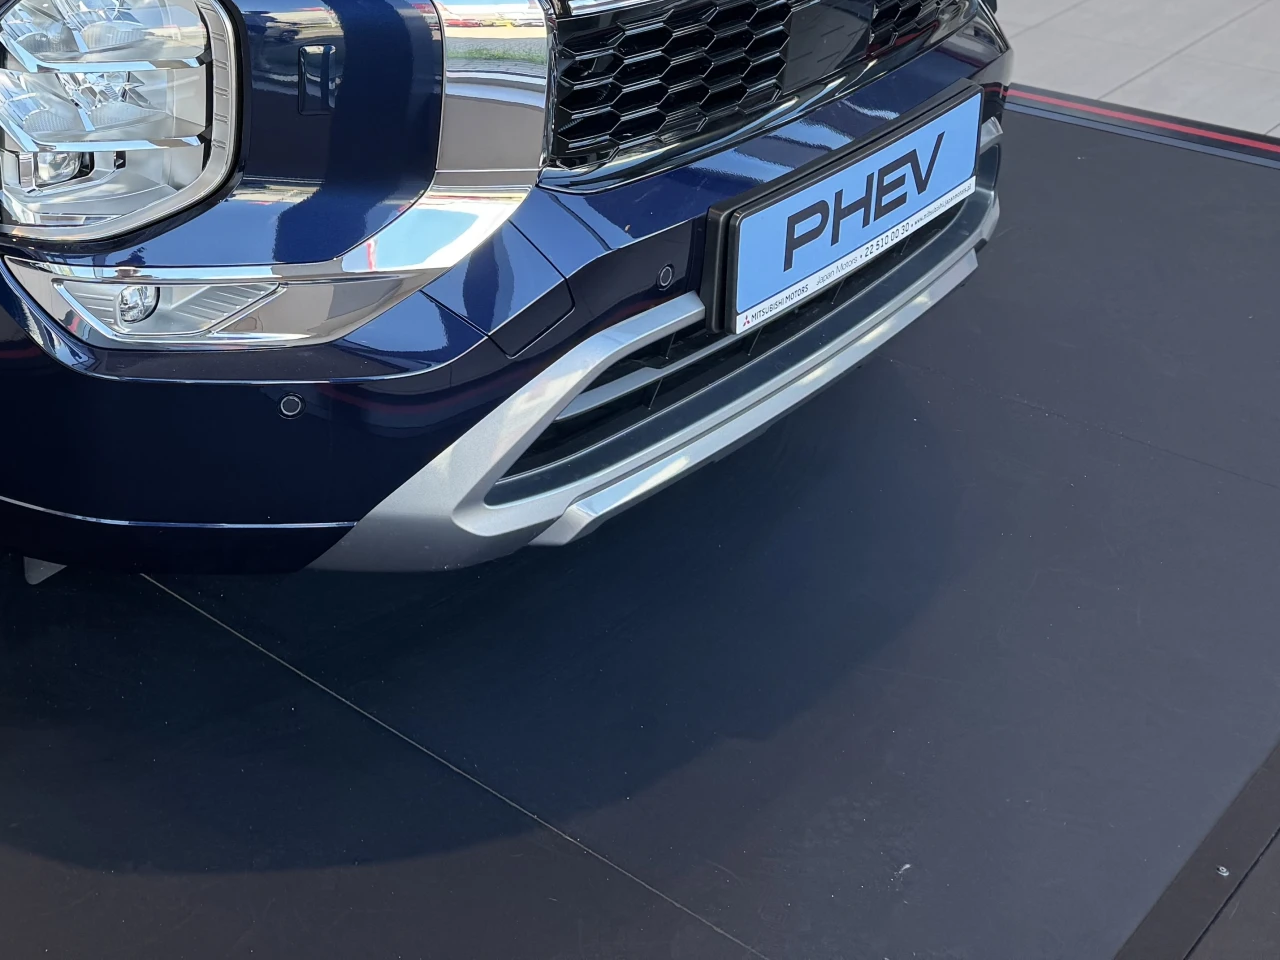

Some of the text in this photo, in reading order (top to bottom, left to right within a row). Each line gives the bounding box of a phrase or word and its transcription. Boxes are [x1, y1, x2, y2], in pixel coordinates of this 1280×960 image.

[783, 131, 945, 272] PHEV
[751, 297, 785, 323] MITSUBISHI
[784, 283, 809, 304] MOTORS
[815, 268, 835, 287] Japan
[835, 256, 858, 277] Motors
[864, 243, 874, 258] 22
[875, 234, 889, 251] 510
[890, 228, 900, 242] 00
[900, 222, 910, 236] 30
